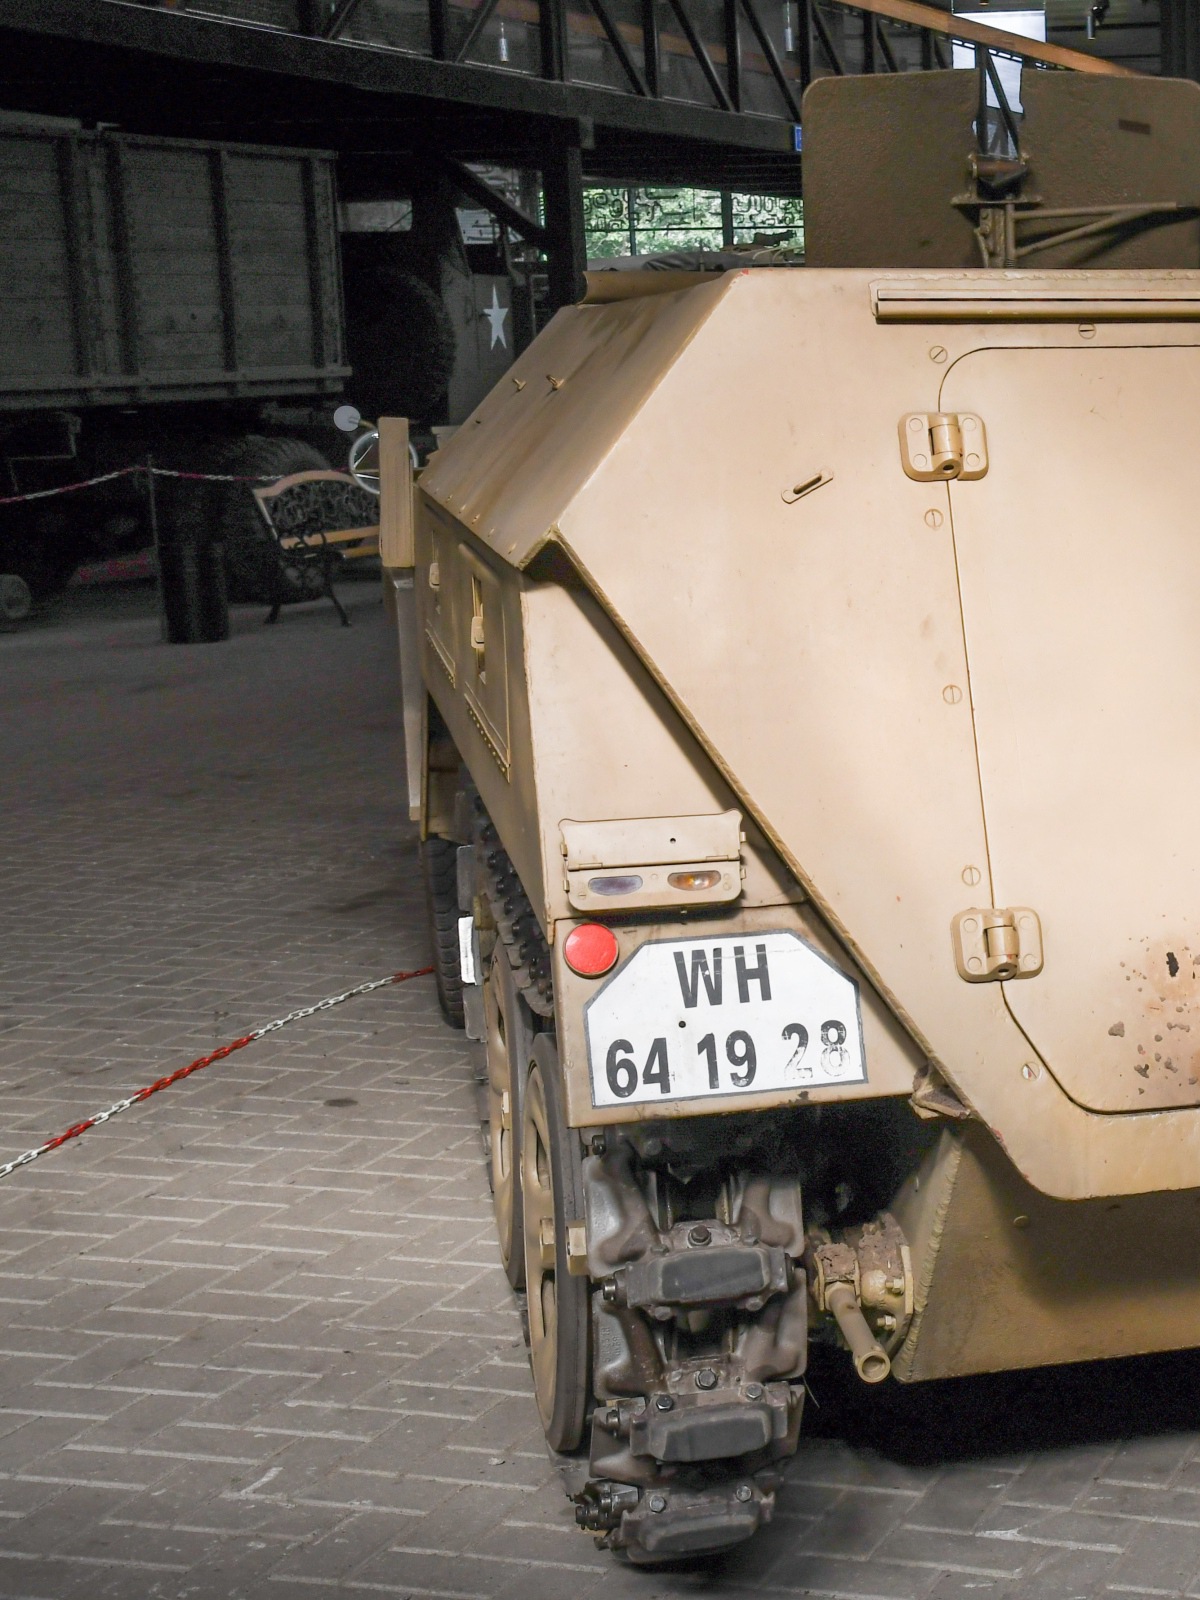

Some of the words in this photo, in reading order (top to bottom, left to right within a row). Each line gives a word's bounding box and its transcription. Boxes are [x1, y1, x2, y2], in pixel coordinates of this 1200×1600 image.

[673, 943, 772, 1009] WH
[605, 1037, 671, 1098] 64
[697, 1030, 757, 1090] 19
[781, 1019, 851, 1082] 28
